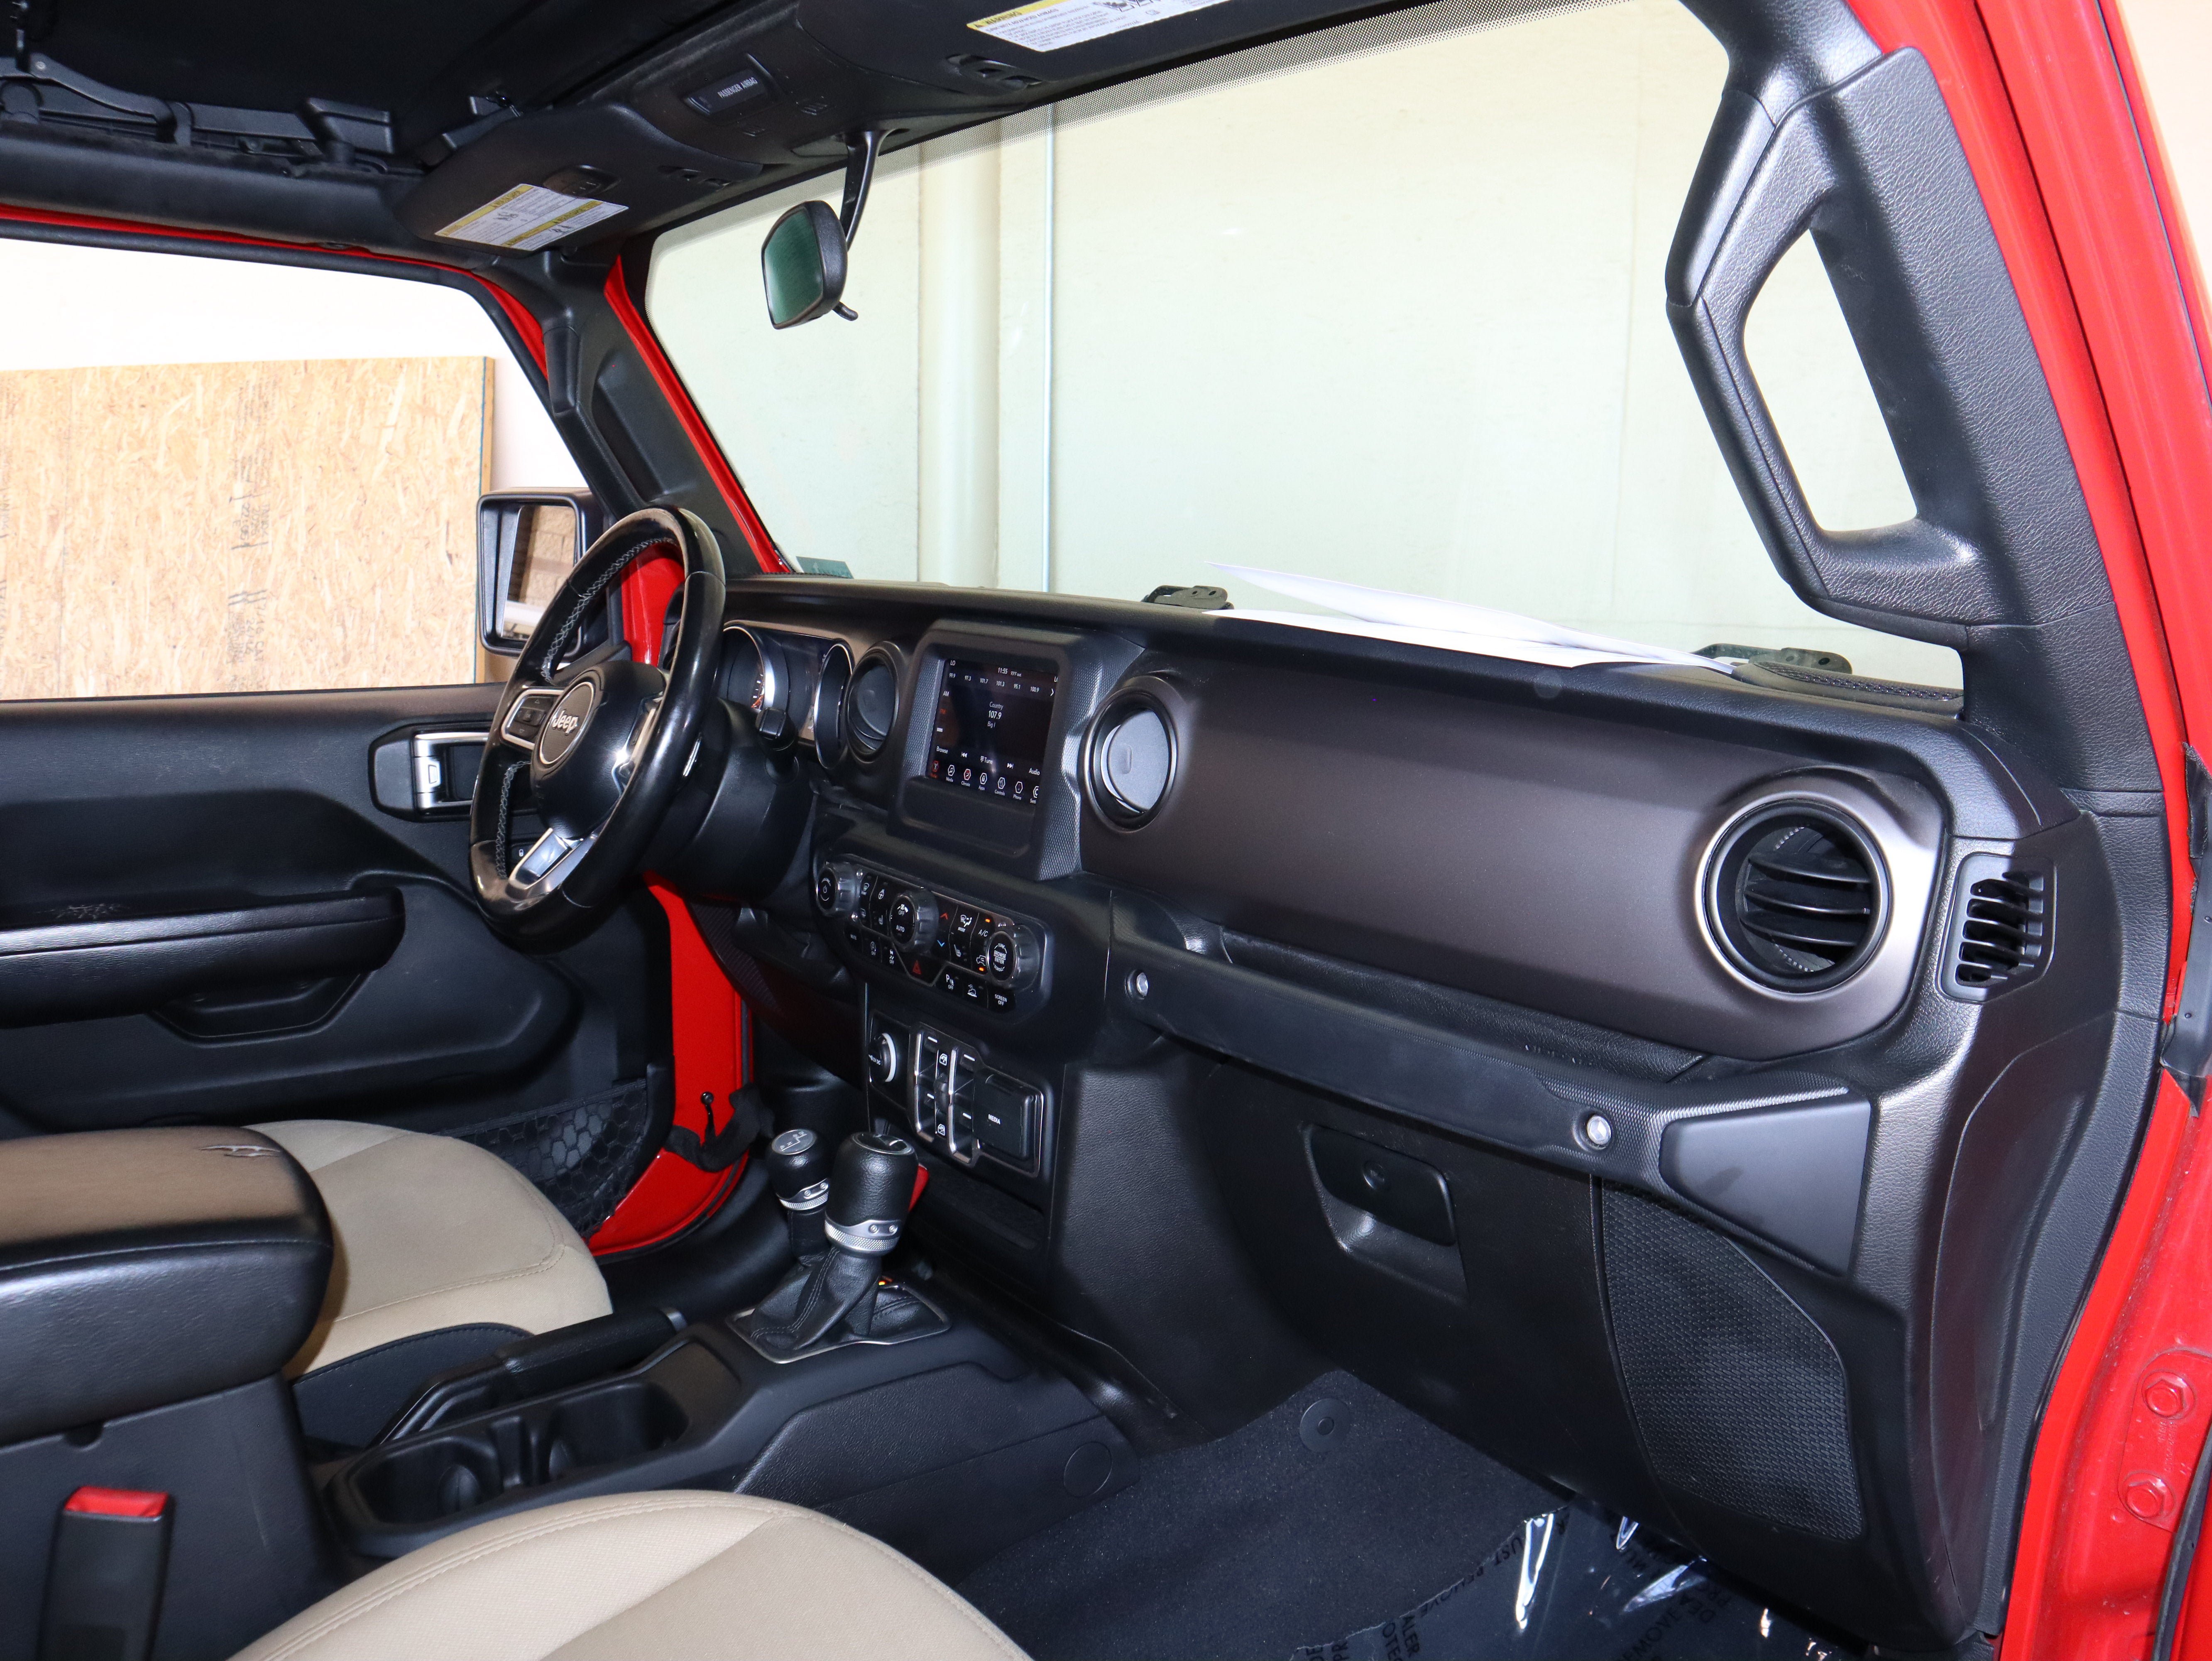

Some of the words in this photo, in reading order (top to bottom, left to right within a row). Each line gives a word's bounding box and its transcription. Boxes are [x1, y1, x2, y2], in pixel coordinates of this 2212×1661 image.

[717, 84, 743, 98] PASSENGER
[740, 77, 758, 89] AIRBAG
[989, 701, 1003, 710] Country
[988, 710, 1002, 720] 107.9
[551, 709, 579, 736] Jeep
[936, 745, 948, 754] Browse
[1028, 767, 1040, 776] Audio
[978, 929, 989, 937] A/C
[993, 950, 1007, 960] BROWSE
[994, 994, 1008, 1003] SCREEN
[988, 1113, 1001, 1125] MEDIA
[1494, 1535, 1523, 1566] UST
